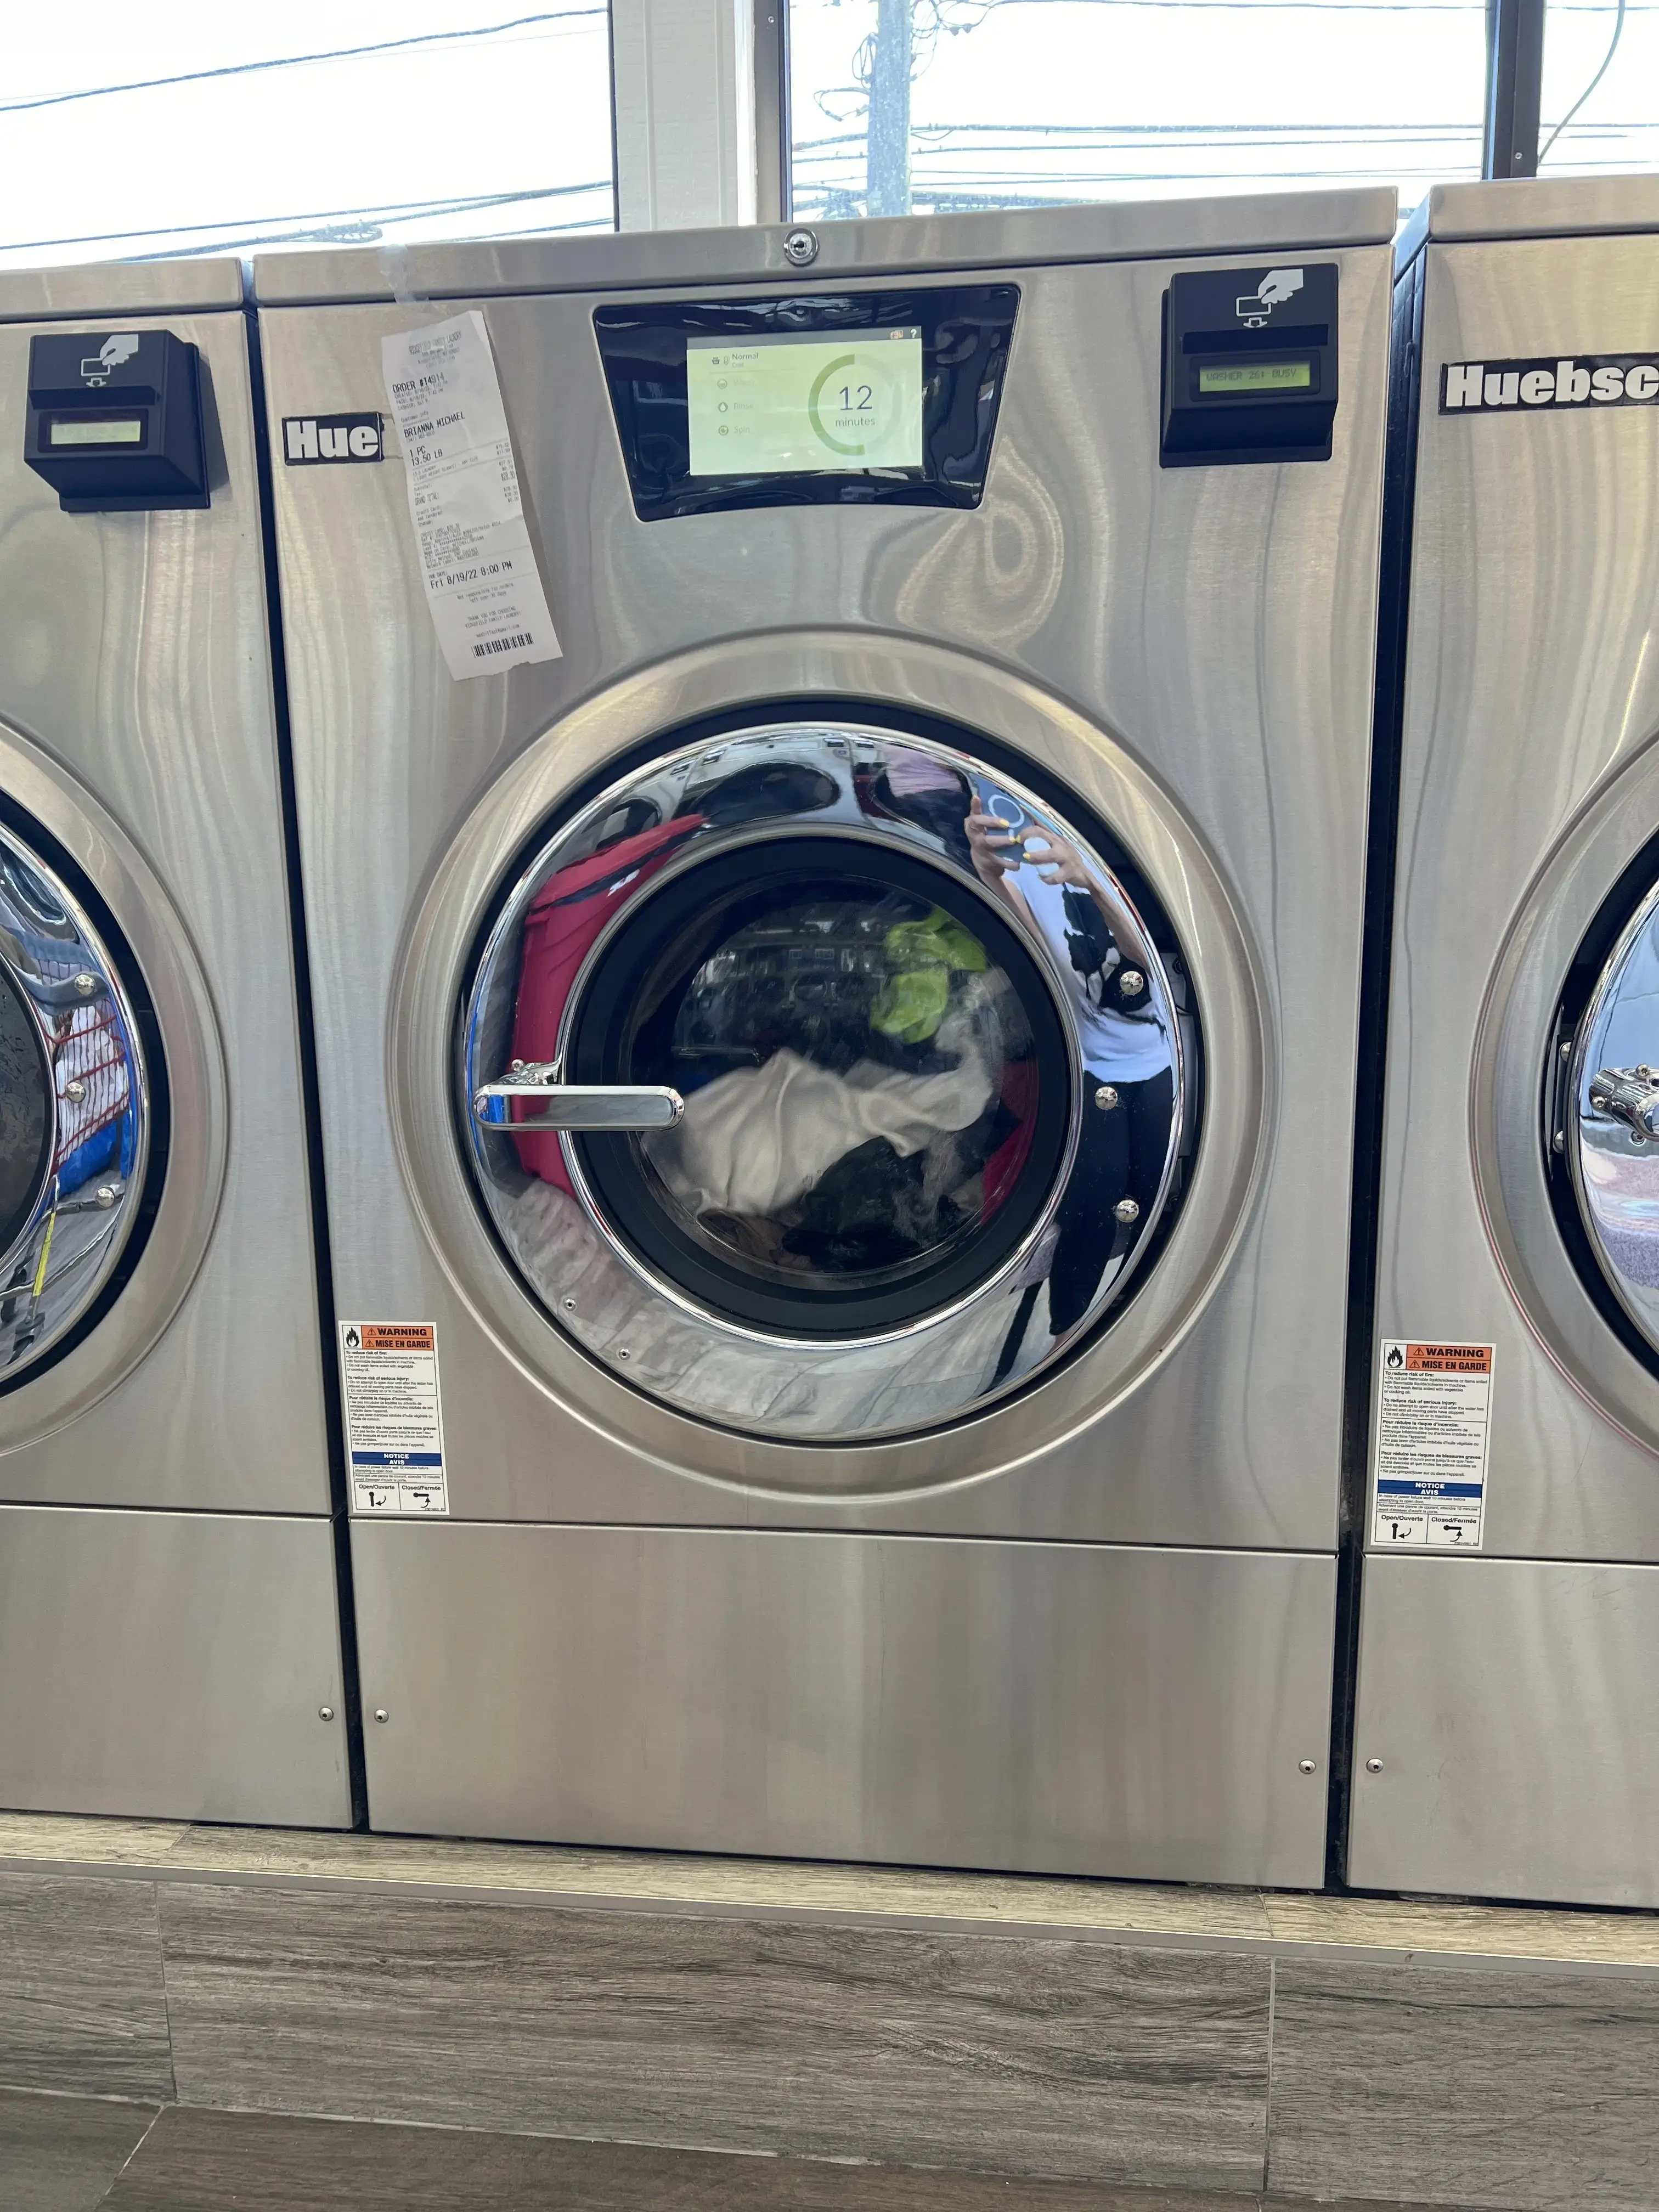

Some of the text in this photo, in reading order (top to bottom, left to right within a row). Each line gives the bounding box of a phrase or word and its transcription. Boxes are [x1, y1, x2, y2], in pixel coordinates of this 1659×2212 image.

[392, 372, 444, 393] ORDER #14914
[1206, 371, 1242, 382] WASHER
[1272, 368, 1296, 378] BUSY
[1446, 360, 1659, 408] Huebsc
[838, 385, 873, 410] 12
[403, 411, 466, 437] BRIANNA MICHAEL
[835, 417, 875, 427] minutes
[734, 426, 750, 435] Spin
[286, 420, 379, 459] Hue
[411, 449, 443, 465] 13.50 LB
[416, 446, 426, 454] PC
[430, 561, 512, 588] Fri 8/19/22 8:00 PM
[1425, 1347, 1484, 1357] WARNING
[1421, 1360, 1444, 1369] MISE
[1458, 1362, 1487, 1370] GARDE
